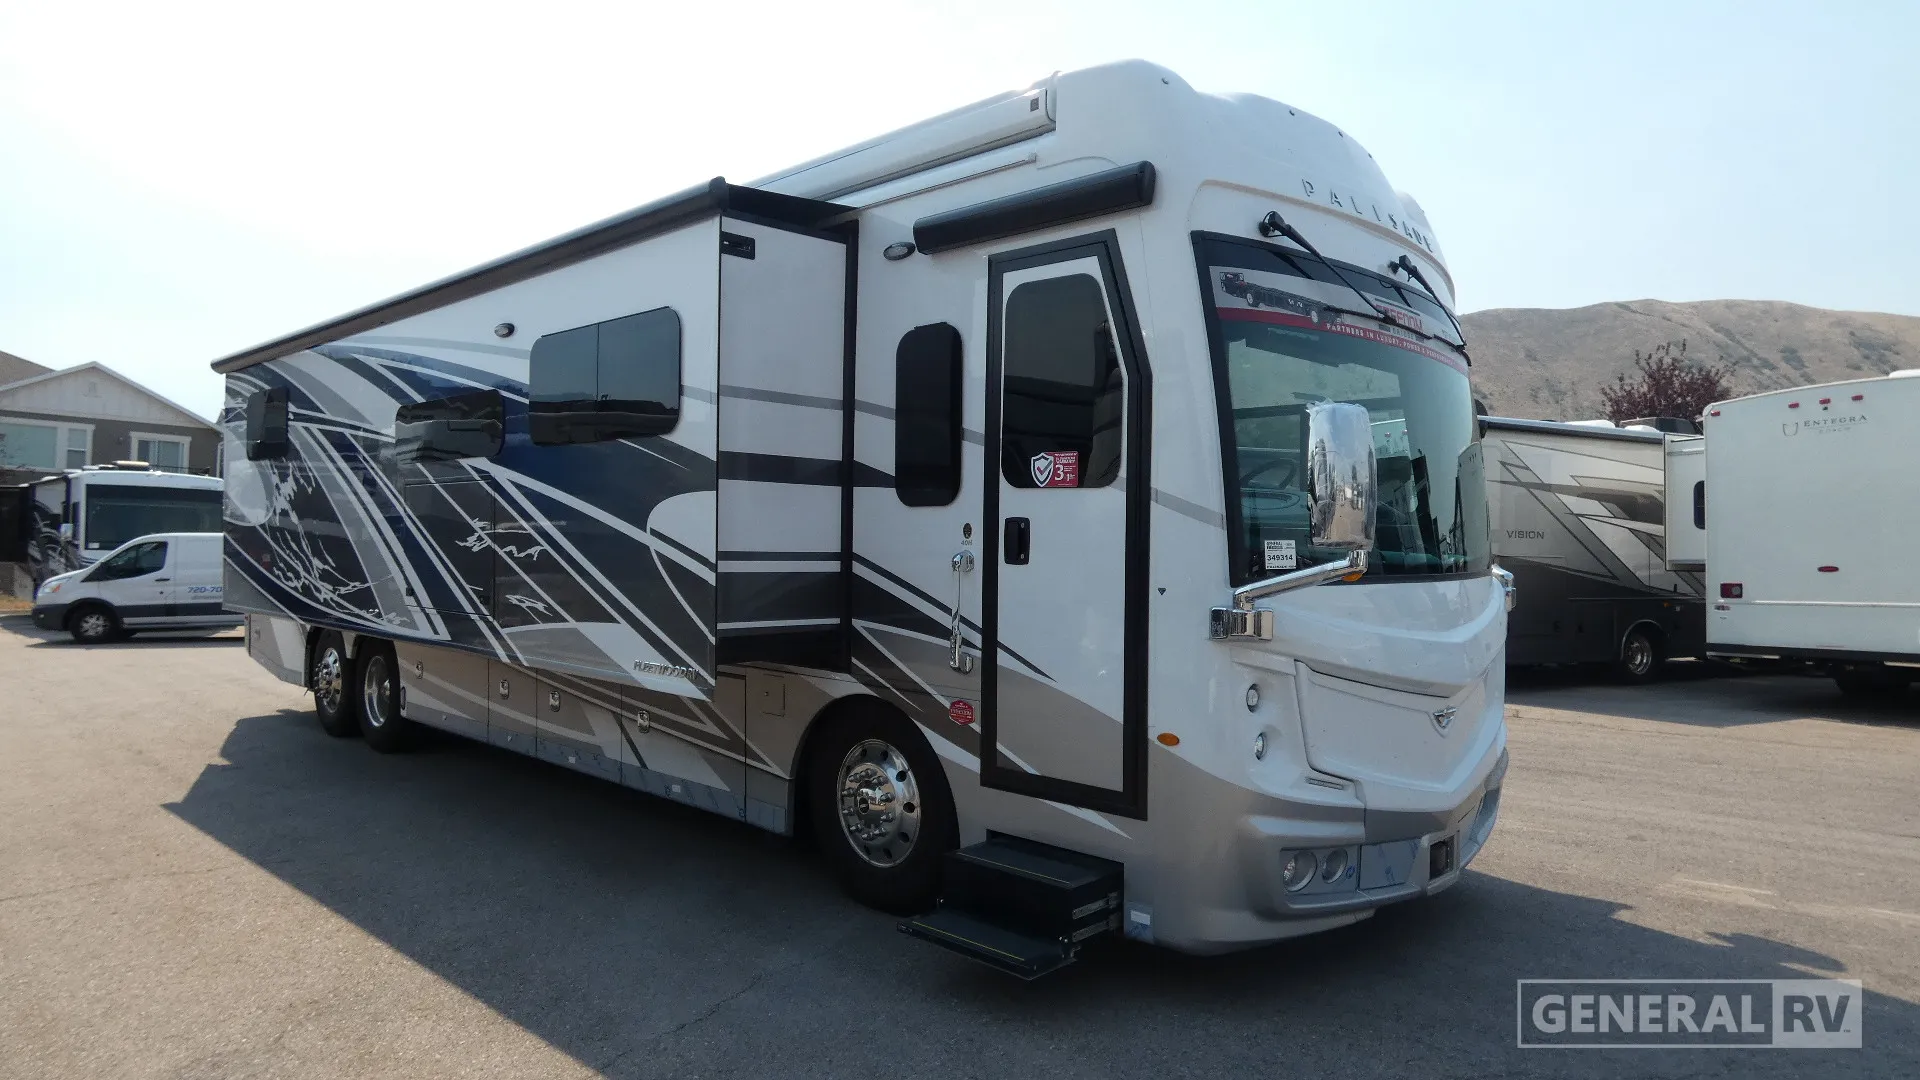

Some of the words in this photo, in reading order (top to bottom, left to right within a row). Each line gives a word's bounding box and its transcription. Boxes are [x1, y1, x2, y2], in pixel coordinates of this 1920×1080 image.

[1301, 178, 1433, 253] PALISADE
[1326, 323, 1363, 337] PARTNERS
[1366, 331, 1374, 339] IN
[1803, 414, 1868, 428] ENTEGRA
[1506, 530, 1545, 540] VISION
[1267, 554, 1294, 562] 349314
